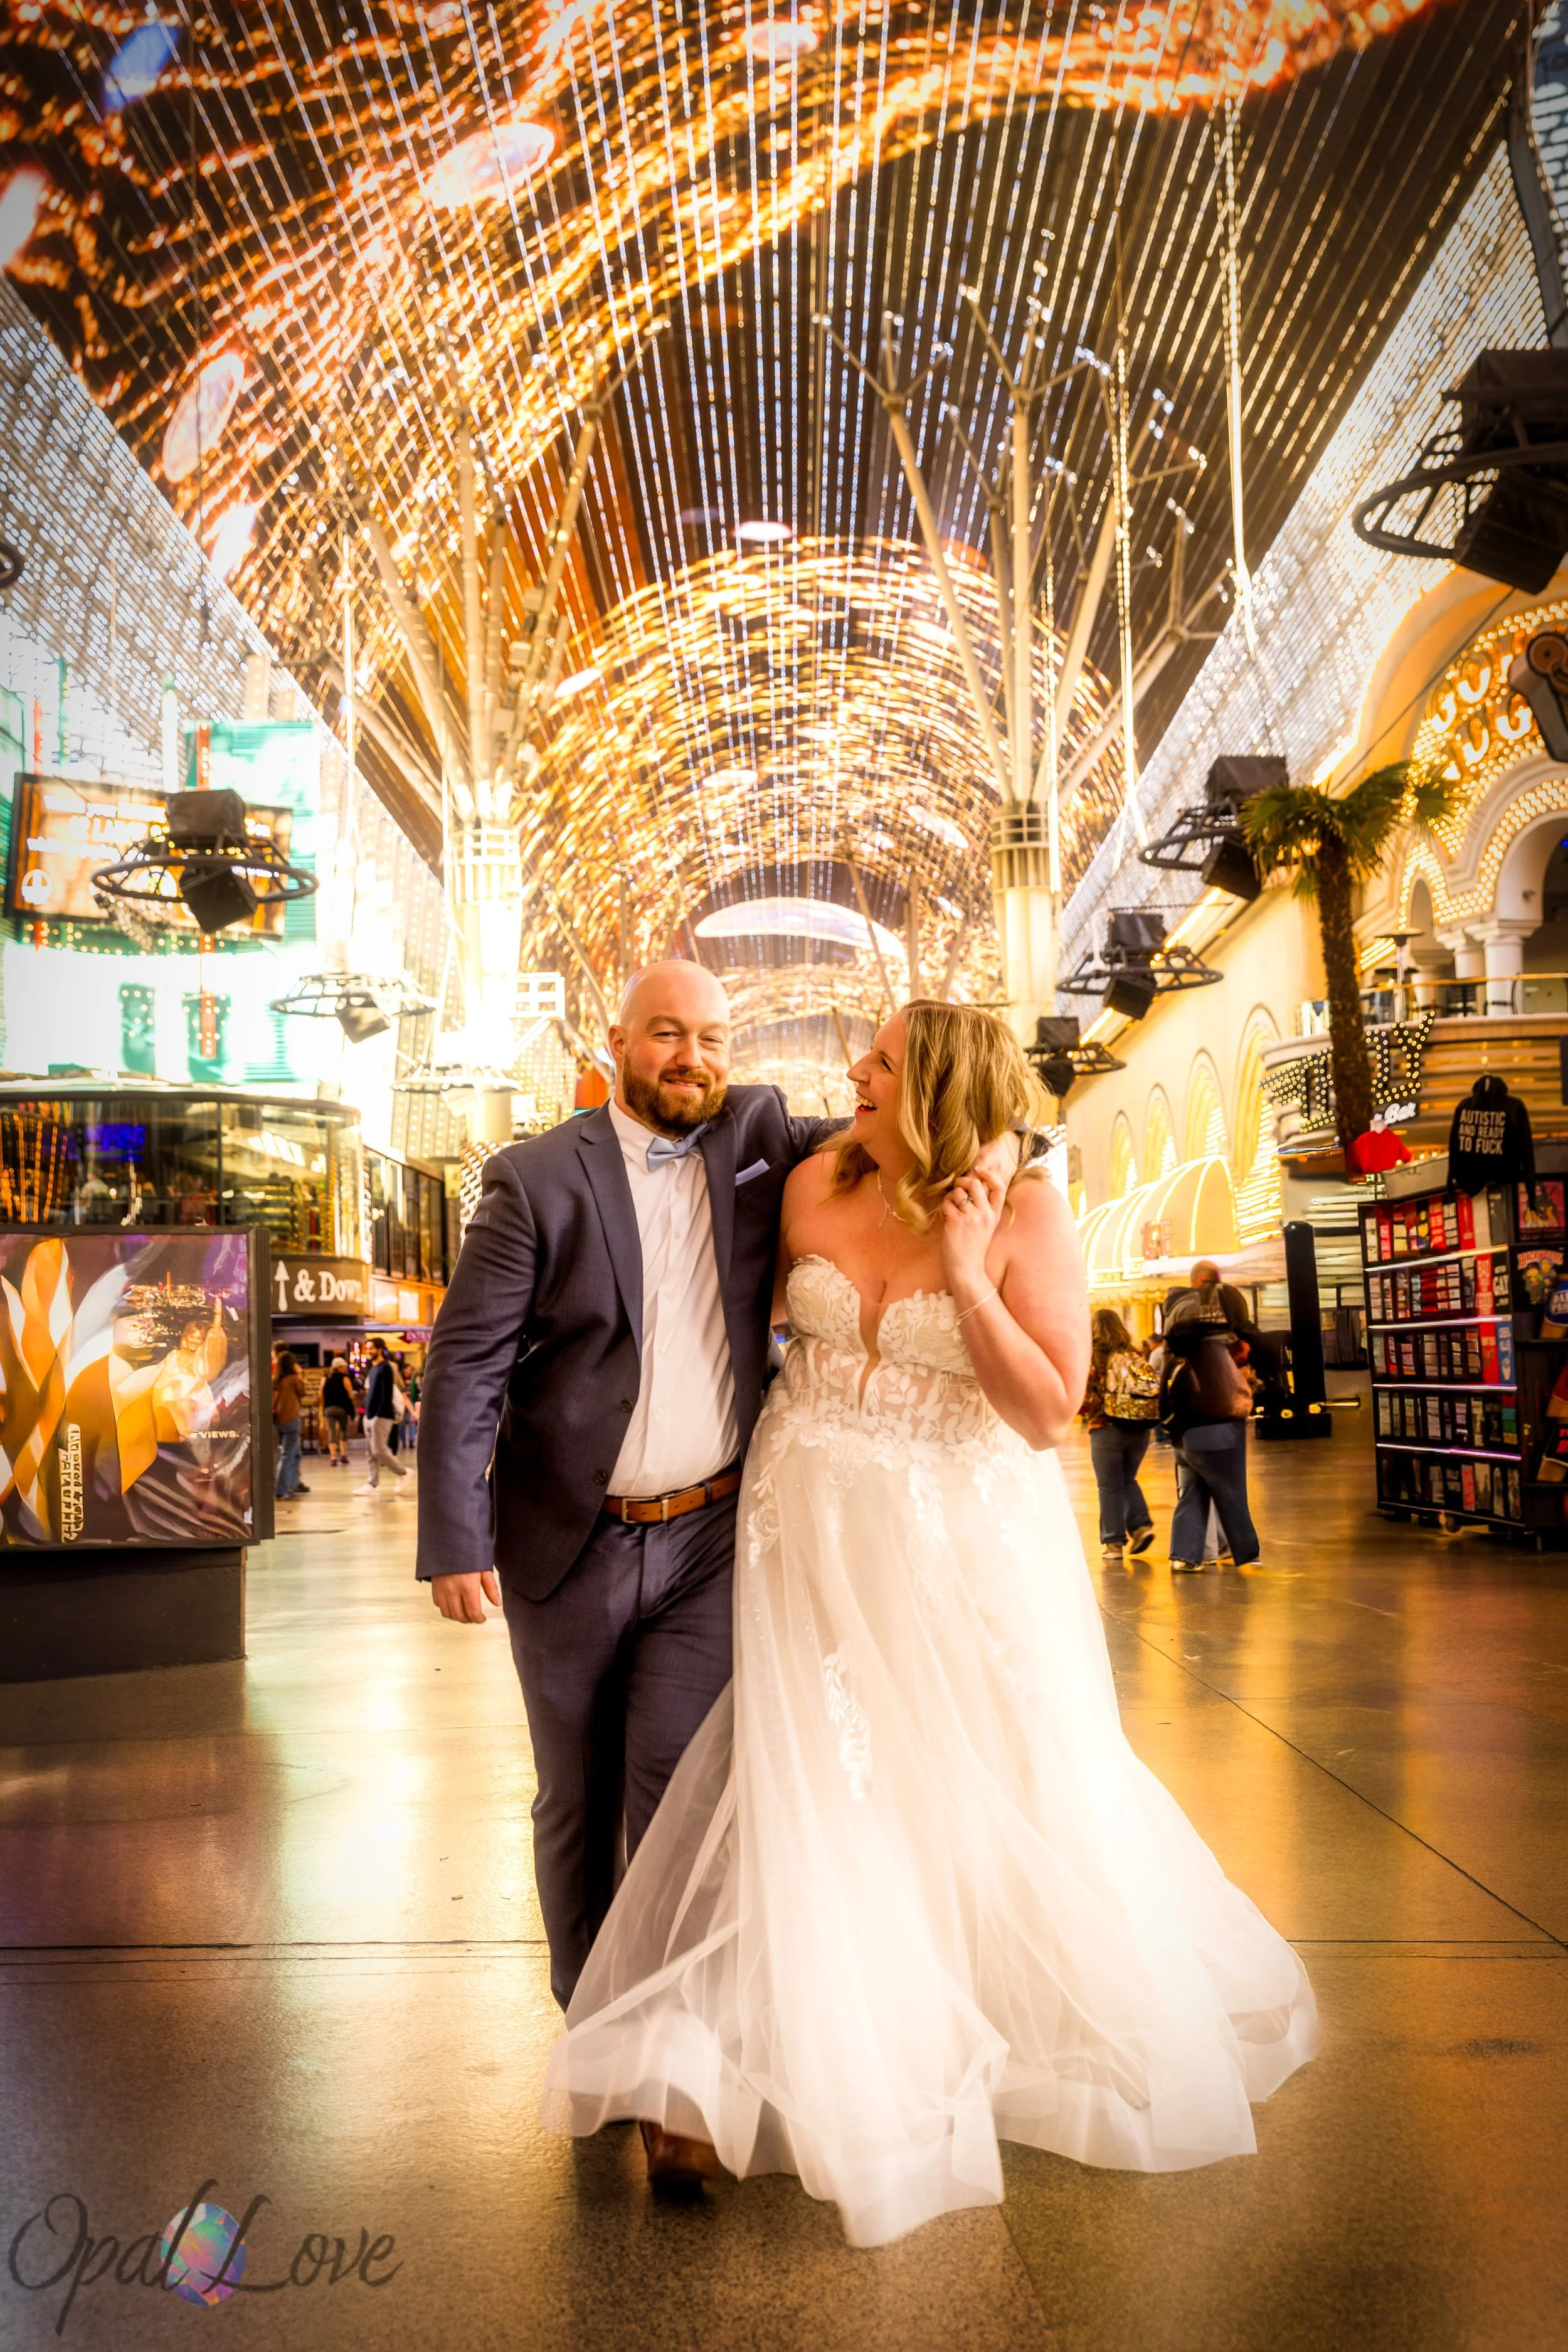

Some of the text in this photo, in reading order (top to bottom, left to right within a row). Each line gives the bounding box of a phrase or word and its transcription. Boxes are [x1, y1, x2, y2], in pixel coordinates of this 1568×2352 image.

[1459, 1109, 1507, 1126] AUTISTIC
[1458, 1124, 1505, 1138] AND READY
[1458, 1136, 1503, 1155] TO FUCK
